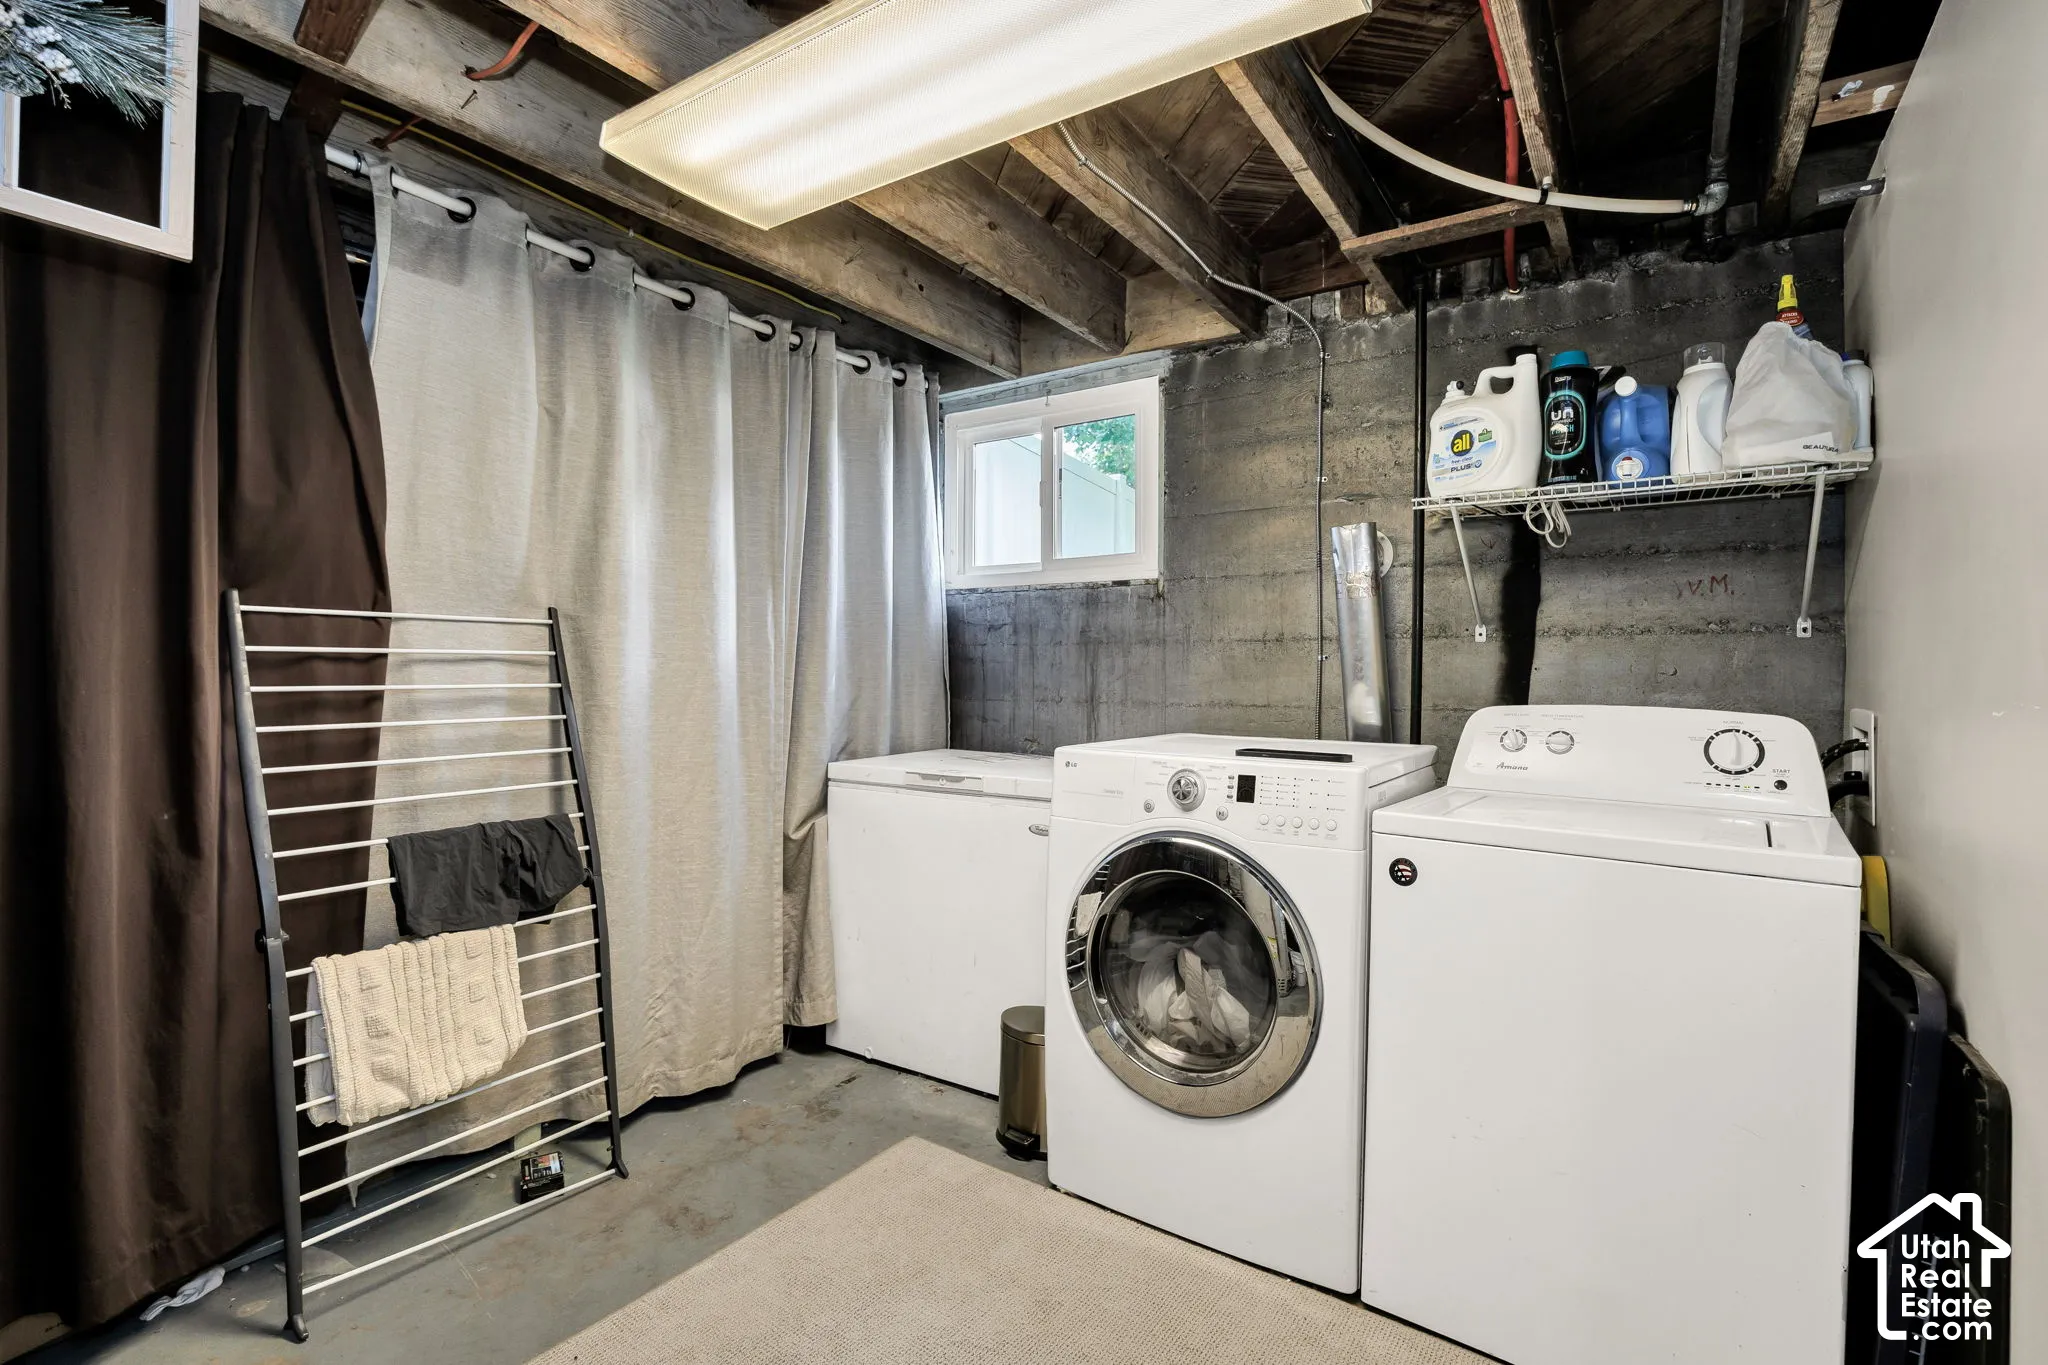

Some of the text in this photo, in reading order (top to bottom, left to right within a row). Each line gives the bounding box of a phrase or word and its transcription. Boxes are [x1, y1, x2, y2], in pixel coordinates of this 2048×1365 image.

[1452, 433, 1470, 452] all
[1450, 463, 1472, 473] PLUS
[1496, 761, 1529, 771] Amana
